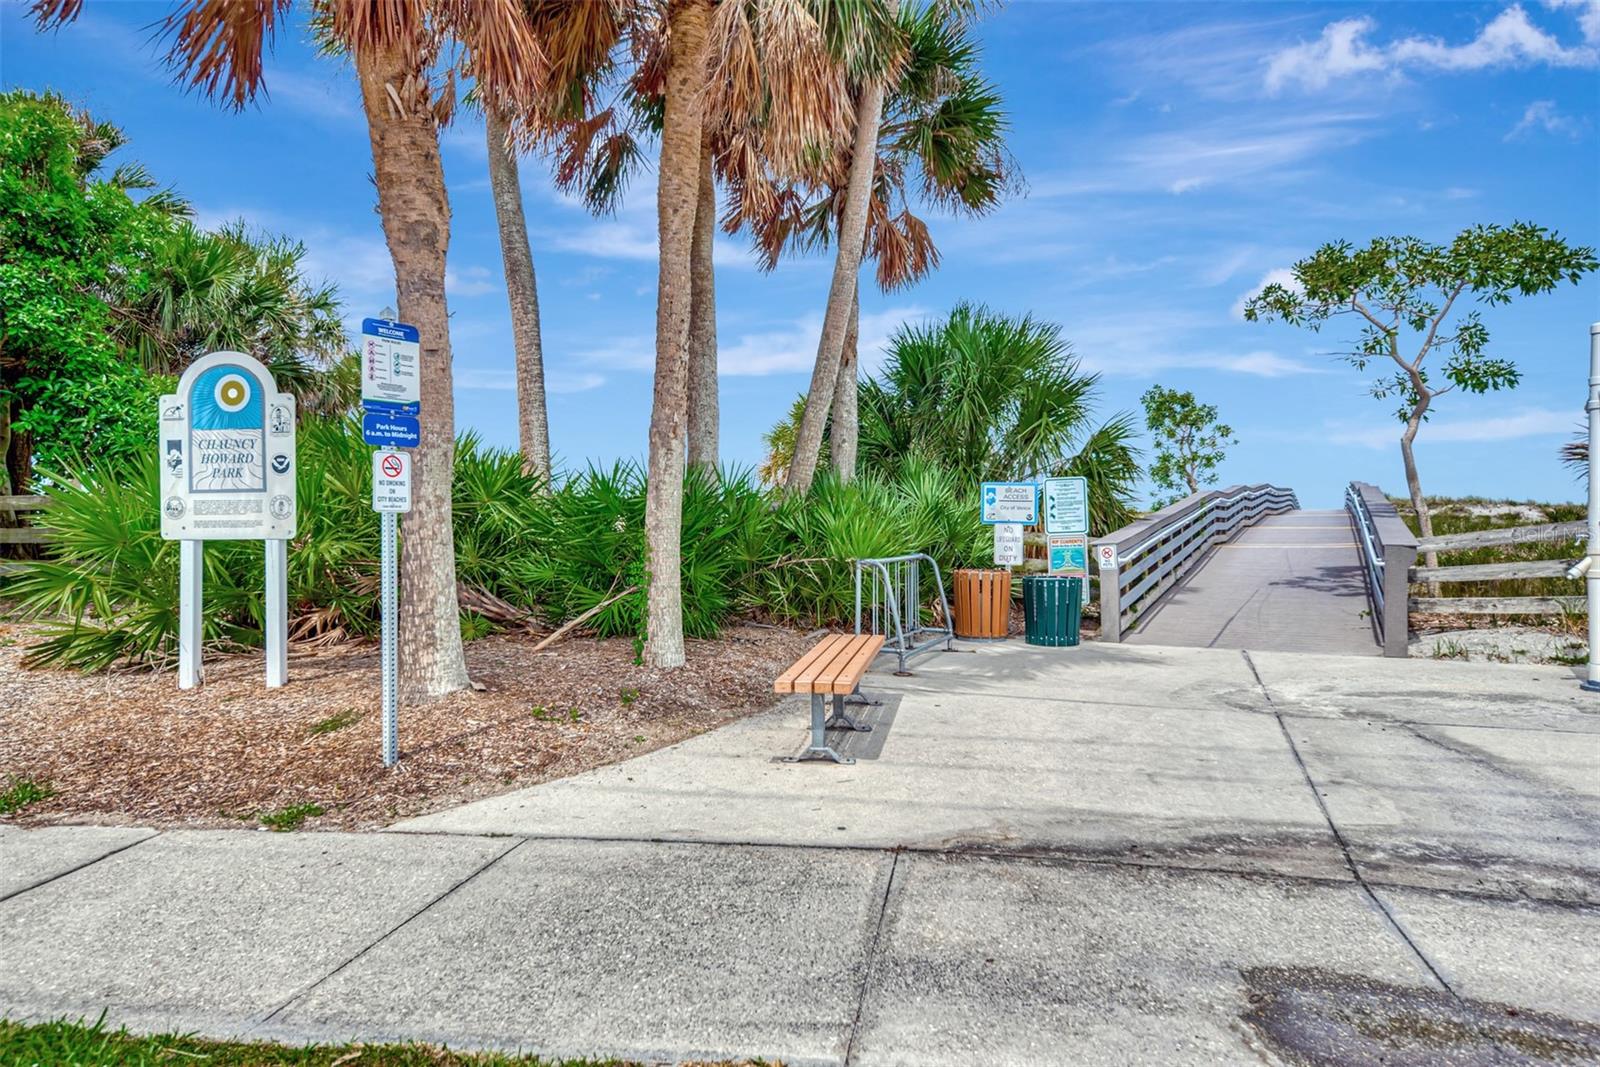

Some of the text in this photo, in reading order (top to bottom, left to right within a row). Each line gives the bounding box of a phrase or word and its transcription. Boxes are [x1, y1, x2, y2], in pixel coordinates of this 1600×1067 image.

[377, 327, 405, 337] WELCOME
[376, 423, 408, 432] Park Hours
[391, 431, 418, 440] Midnight
[198, 438, 258, 451] CHAUNCY
[200, 453, 254, 464] HOWARD
[211, 467, 244, 479] PARK
[1004, 526, 1014, 534] NO
